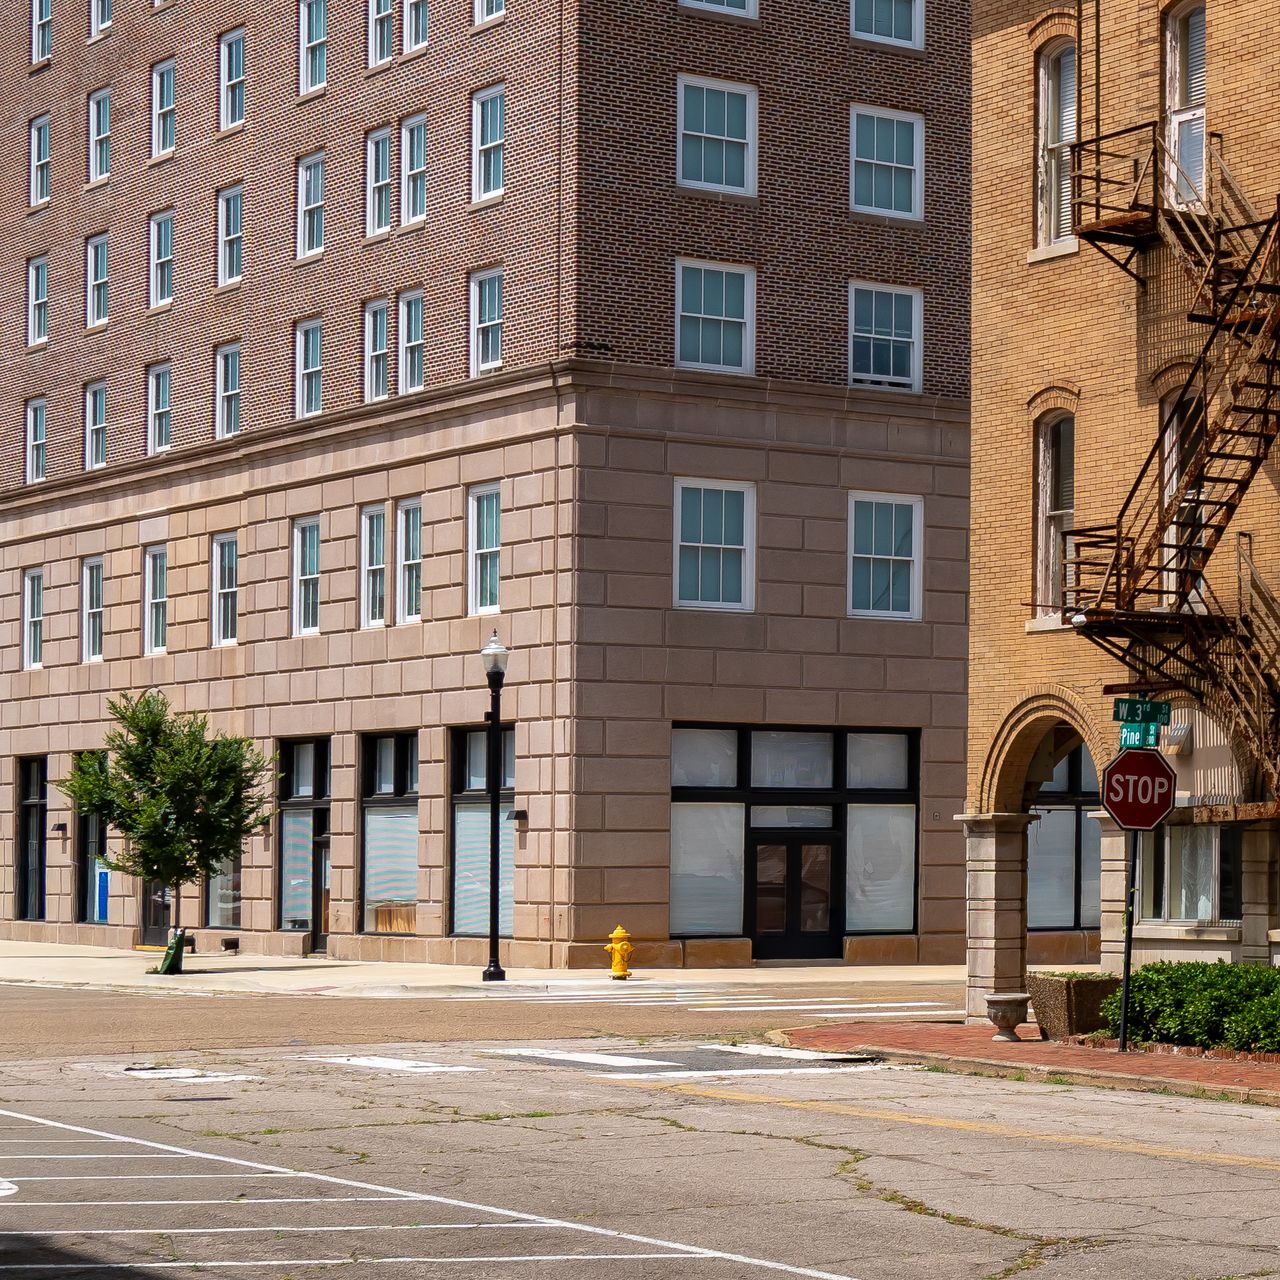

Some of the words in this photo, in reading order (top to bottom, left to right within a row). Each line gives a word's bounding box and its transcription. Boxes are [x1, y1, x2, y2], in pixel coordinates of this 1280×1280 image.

[1119, 702, 1131, 720] W.
[1135, 703, 1151, 721] 3rd
[1162, 704, 1169, 714] St
[1157, 714, 1168, 724] 100
[1121, 728, 1140, 745] Pine
[1149, 725, 1156, 735] St
[1109, 773, 1169, 804] STOP
